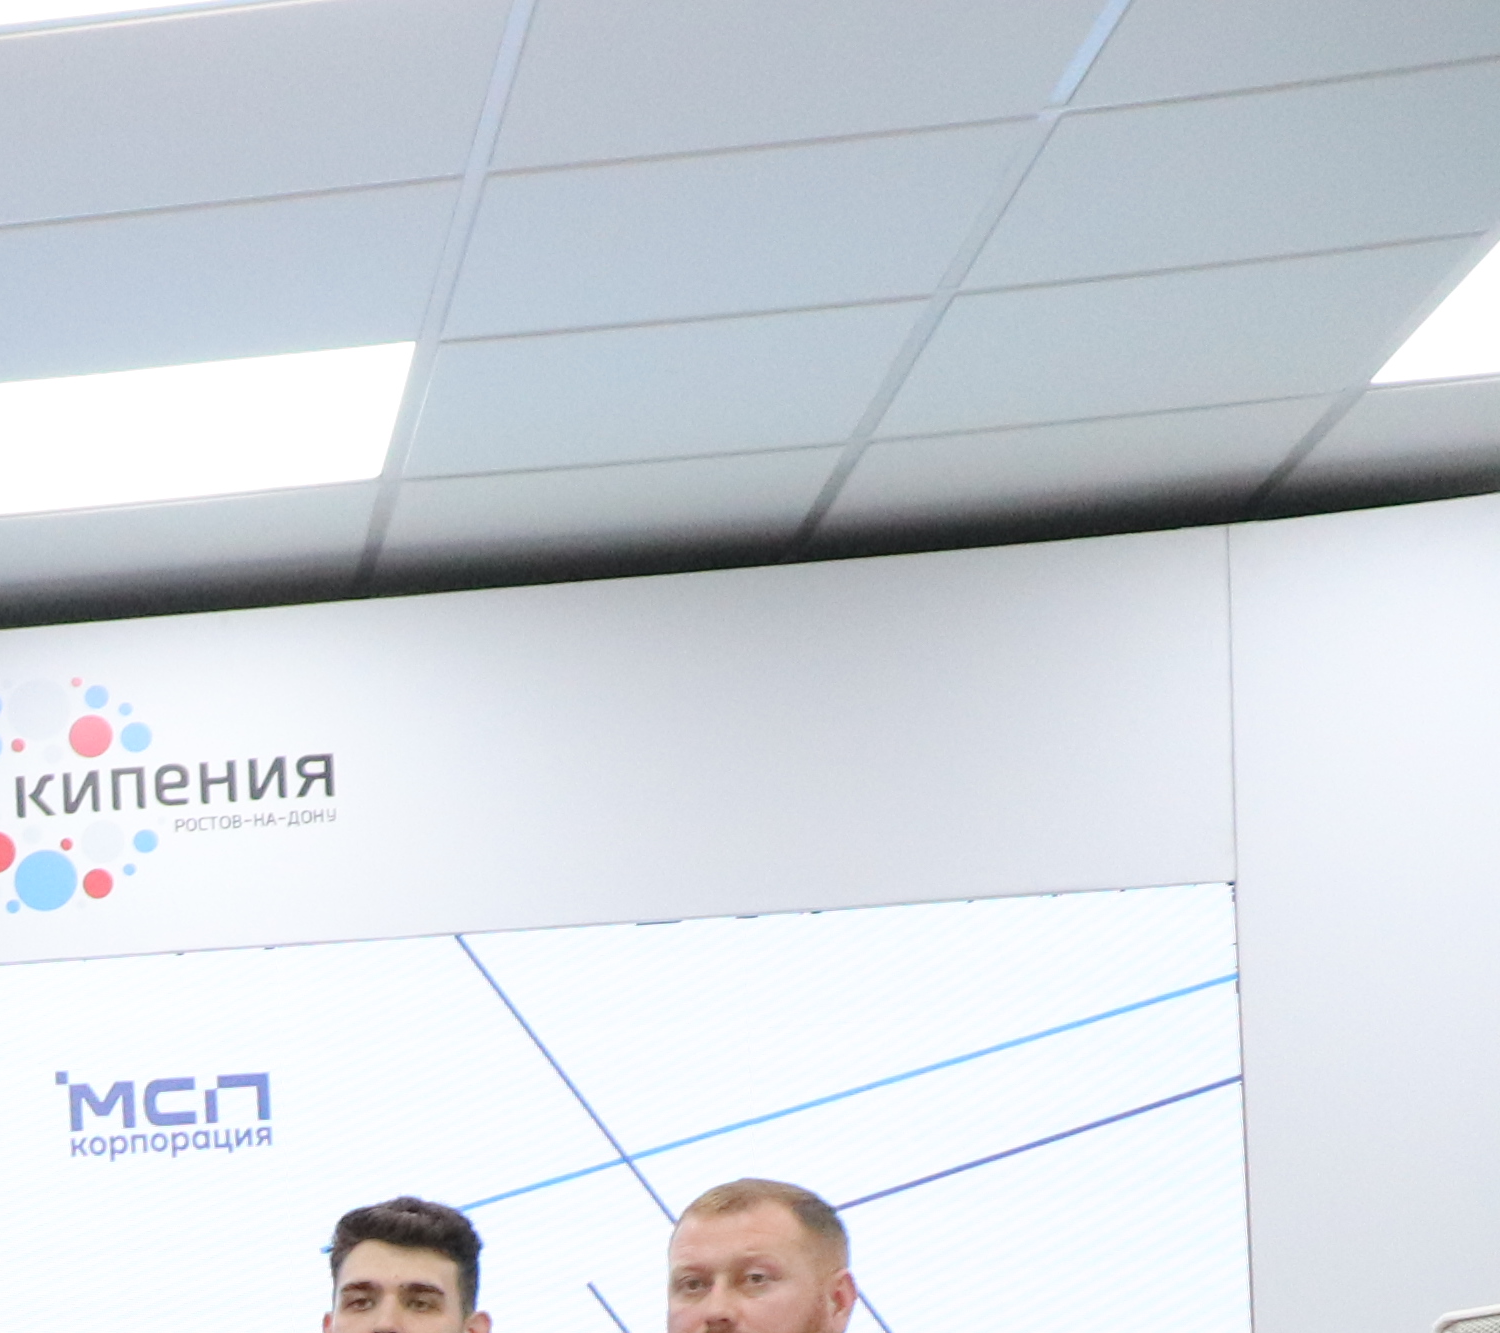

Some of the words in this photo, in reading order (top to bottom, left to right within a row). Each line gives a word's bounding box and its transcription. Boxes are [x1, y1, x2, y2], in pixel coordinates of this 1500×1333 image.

[15, 752, 337, 818] кипения
[174, 808, 338, 833] РОСТОВ-НА-ДОНУ
[55, 1071, 272, 1132] МСП
[70, 1125, 273, 1163] корпорация
